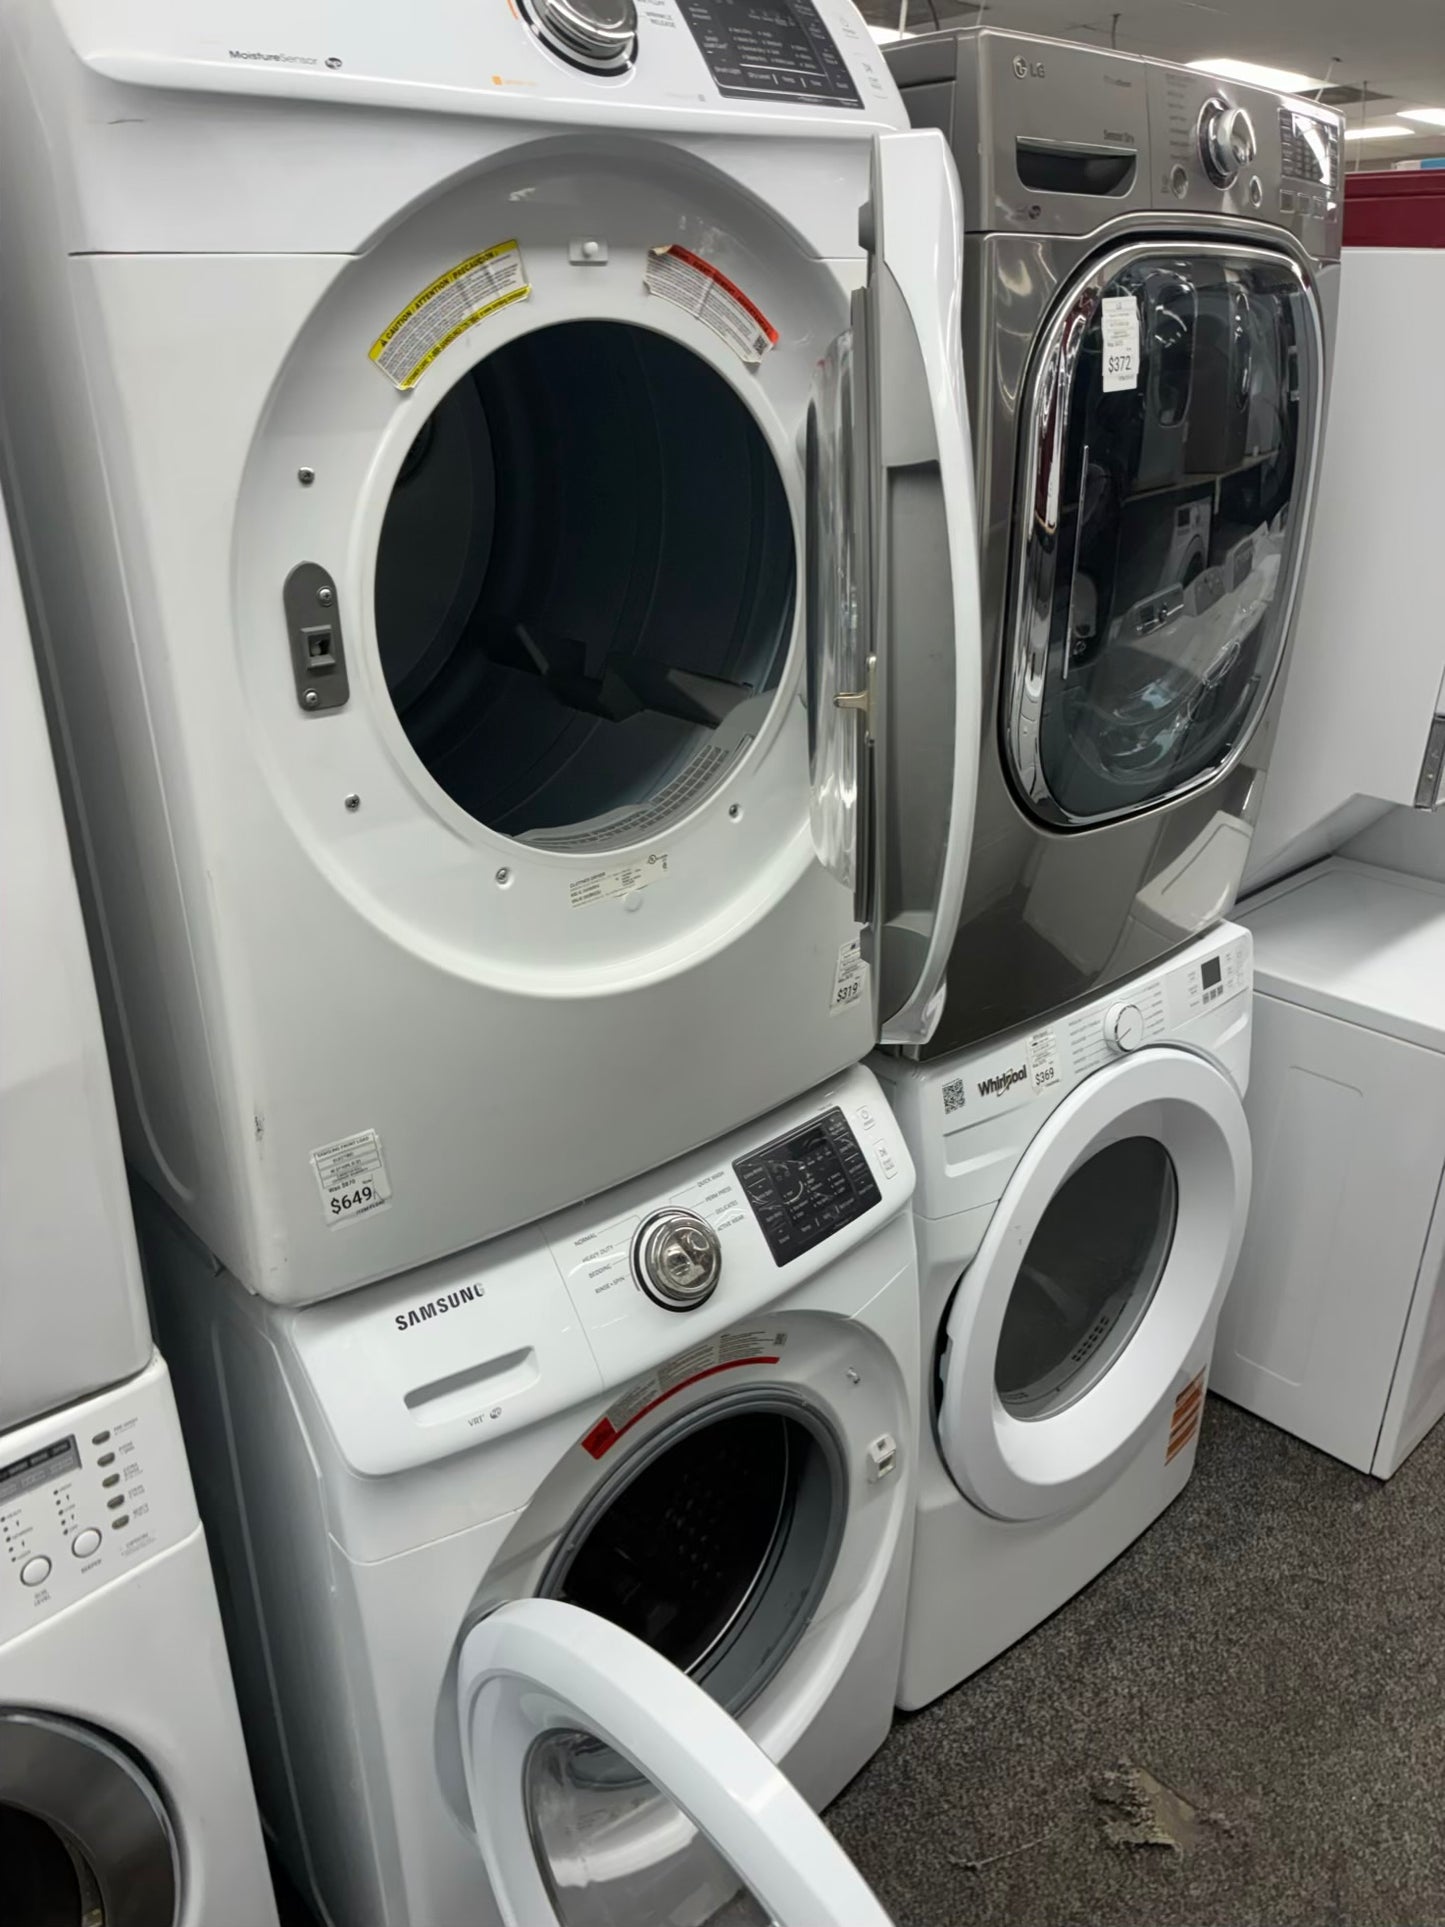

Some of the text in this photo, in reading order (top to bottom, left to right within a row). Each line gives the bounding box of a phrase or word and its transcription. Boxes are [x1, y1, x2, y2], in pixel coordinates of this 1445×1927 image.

[385, 310, 413, 340] CAUTION
[415, 277, 450, 310] ATTENTION
[1108, 355, 1131, 373] $372
[837, 982, 858, 1003] $319
[977, 1064, 1028, 1097] Whirlpool
[1035, 1067, 1054, 1086] $369
[330, 1186, 372, 1215] $649
[574, 1233, 597, 1247] NORMAL
[395, 1282, 485, 1331] SAMSUNG
